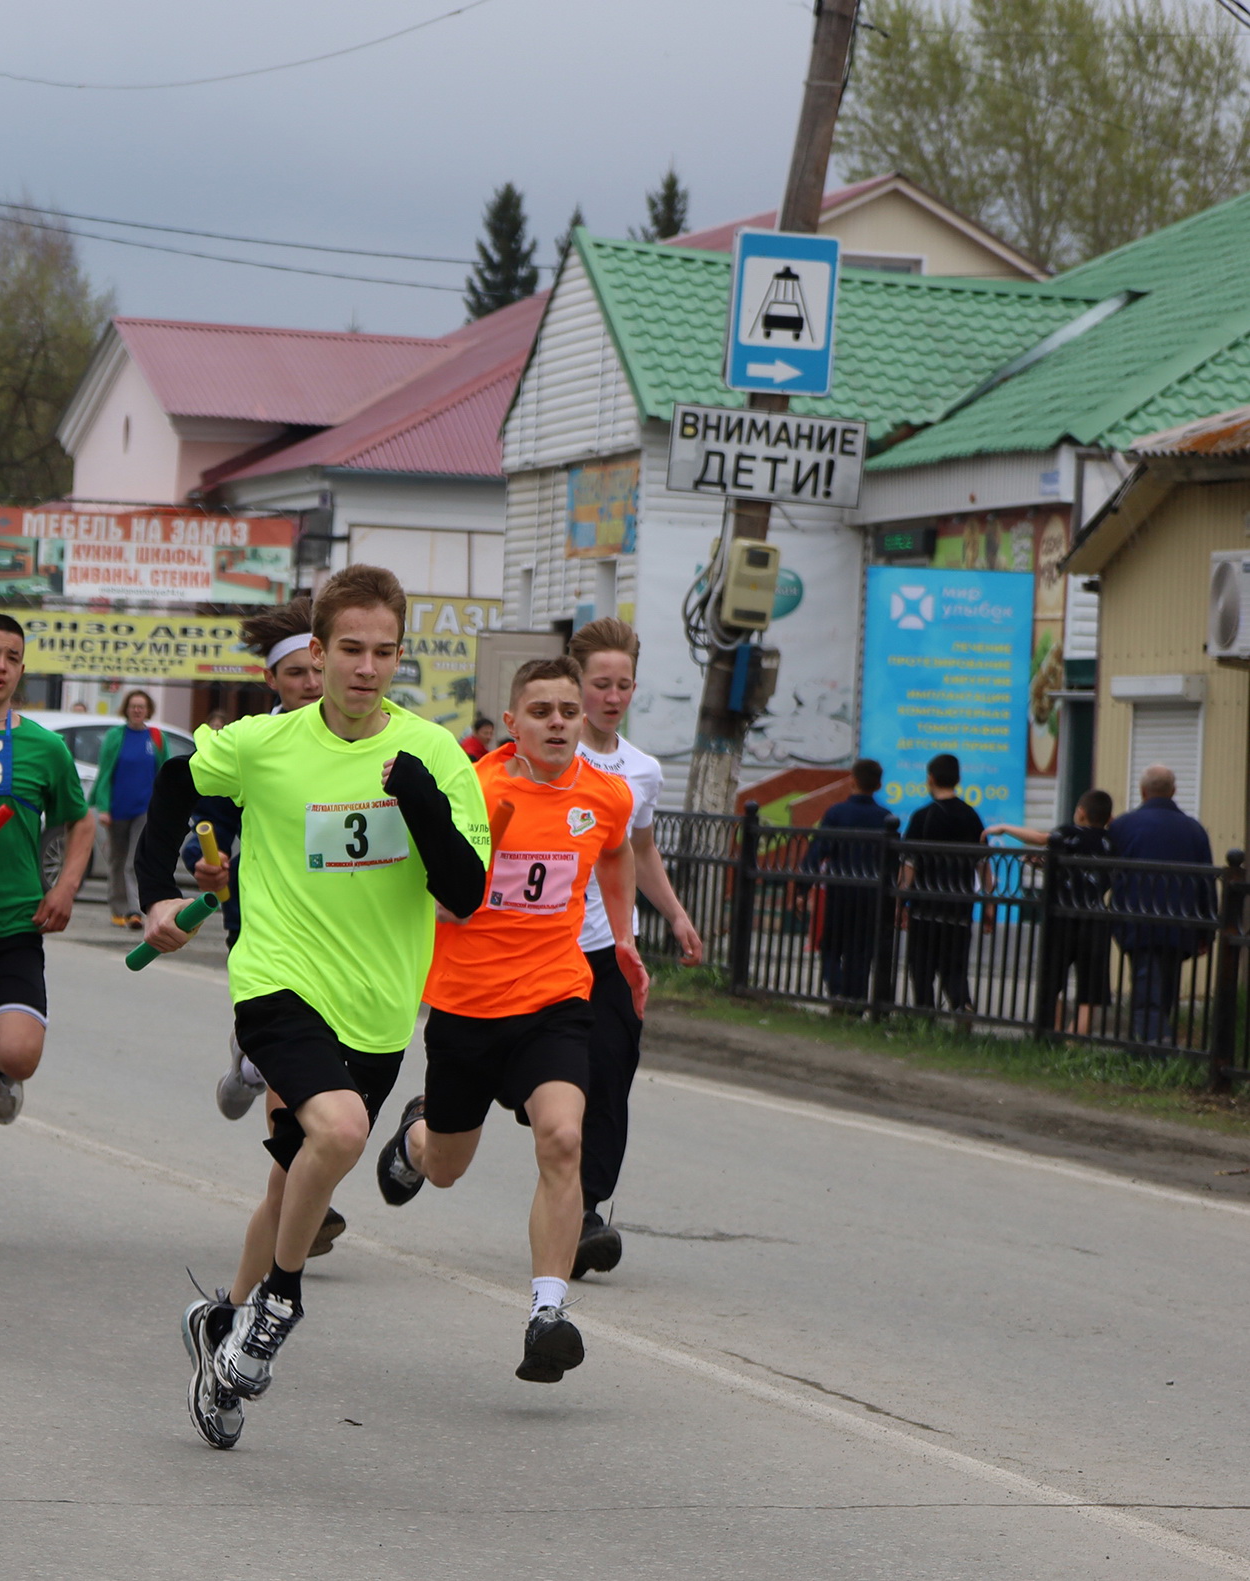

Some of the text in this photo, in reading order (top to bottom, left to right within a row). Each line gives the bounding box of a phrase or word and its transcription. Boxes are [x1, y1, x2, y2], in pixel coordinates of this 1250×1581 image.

[679, 410, 859, 458] ВНИМАНИЕ
[693, 450, 836, 499] ДЕТИ!
[22, 512, 249, 546] МЕБЕЛЬ НА ЗАКАЗ
[150, 568, 211, 588] СТЕНКИ
[38, 636, 223, 658] ИНСТРУМЕНТ
[344, 812, 369, 859] 3
[523, 862, 547, 903] 9
